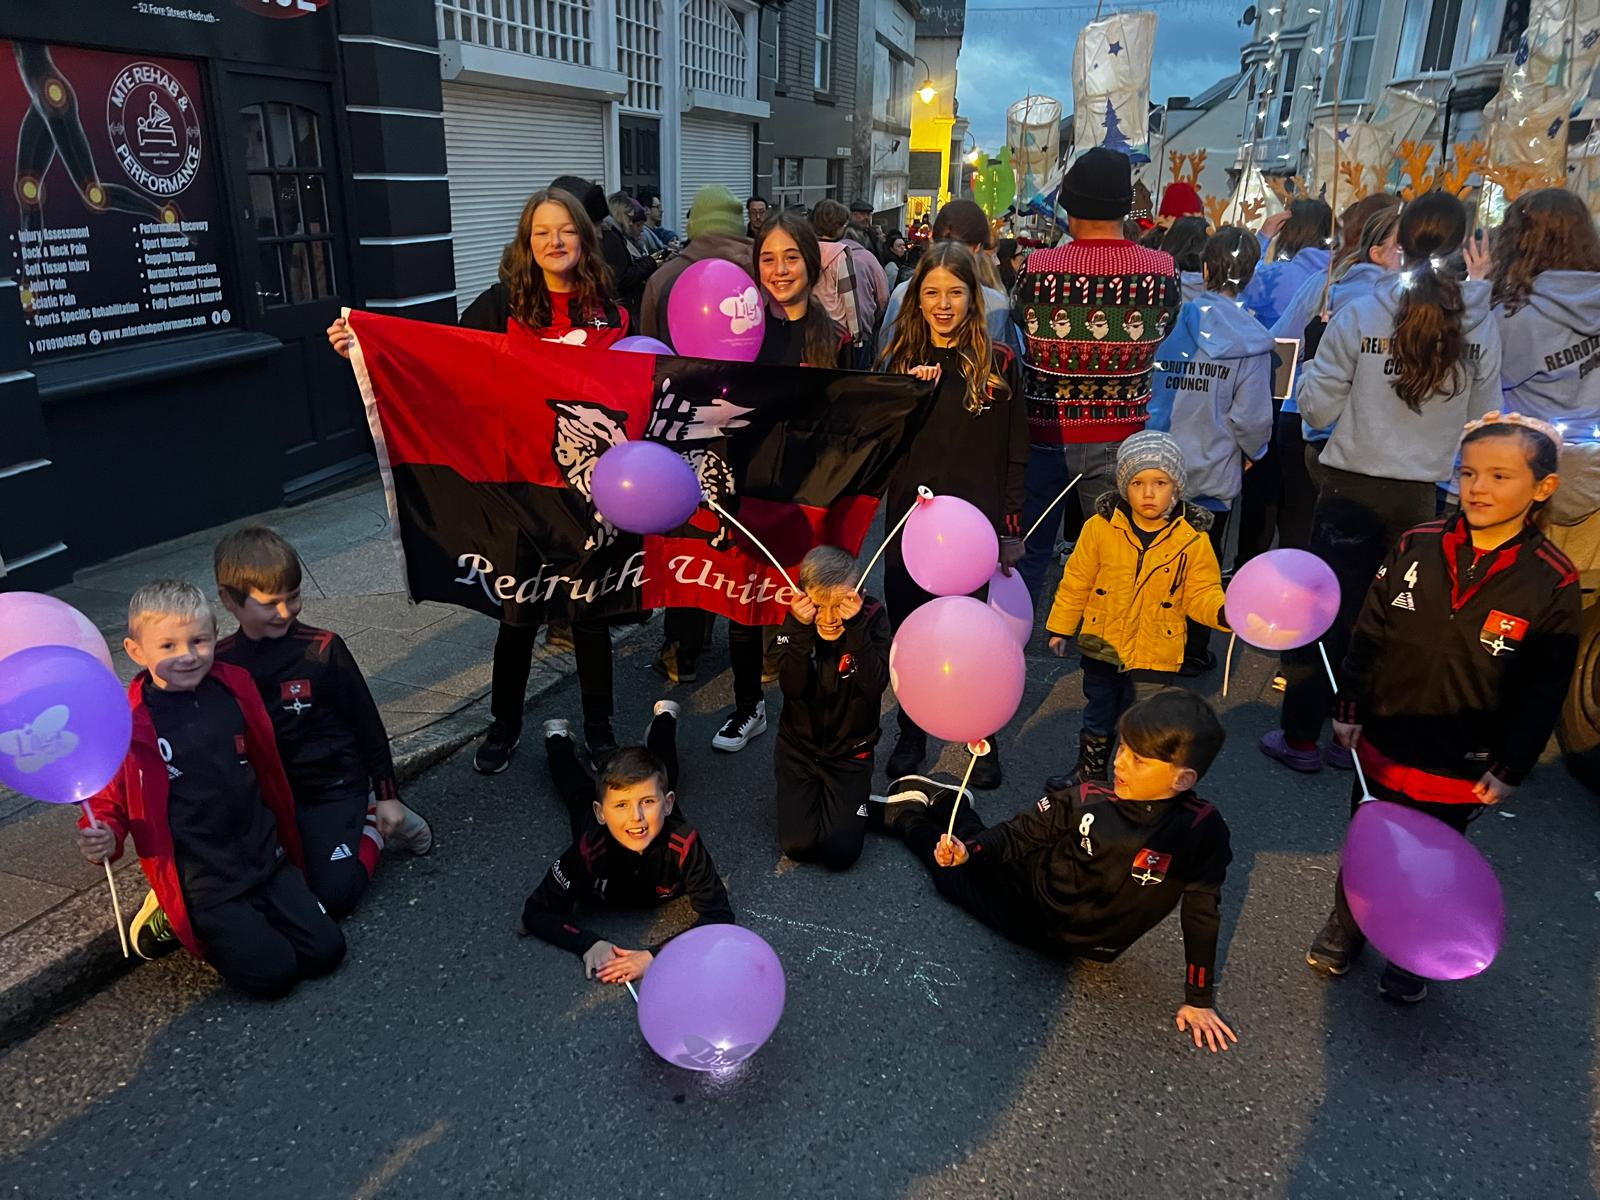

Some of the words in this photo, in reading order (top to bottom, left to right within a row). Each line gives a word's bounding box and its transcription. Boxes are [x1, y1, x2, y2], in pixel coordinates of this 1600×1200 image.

[149, 4, 166, 16] Fore
[167, 6, 188, 19] Street
[188, 9, 215, 23] Redruth
[112, 72, 135, 108] MTE
[133, 66, 179, 98] REHAB
[177, 96, 188, 112] &
[116, 144, 200, 193] PERFORMANCE
[18, 229, 43, 243] Injury
[43, 226, 90, 240] Assessment
[180, 220, 209, 232] Recovery
[21, 246, 42, 259] Back
[49, 244, 70, 257] Neck
[70, 242, 87, 255] Pain
[142, 238, 160, 251] Sport
[160, 237, 189, 248] Massage
[144, 252, 171, 265] Cupping
[171, 250, 196, 262] Therapy
[24, 263, 41, 276] Soft
[41, 262, 68, 275] Tissue
[67, 259, 90, 272] Injury
[178, 263, 217, 276] Compression
[29, 280, 49, 292] Joint
[49, 277, 67, 291] Pain
[149, 282, 170, 295] Online
[170, 279, 198, 292] Personal
[197, 276, 221, 288] Training
[31, 295, 58, 310] Sciatic
[59, 292, 76, 306] Pain
[152, 297, 168, 310] Fully
[168, 293, 195, 308] Qualified
[34, 312, 60, 328] Sports
[60, 307, 92, 324] Specific
[91, 301, 140, 319] Rehabilitation
[1198, 362, 1231, 380] YOUTH
[1165, 376, 1210, 393] COUNCIL
[454, 550, 651, 606] Redruth
[1403, 561, 1419, 589] 4
[1078, 812, 1095, 837] 8
